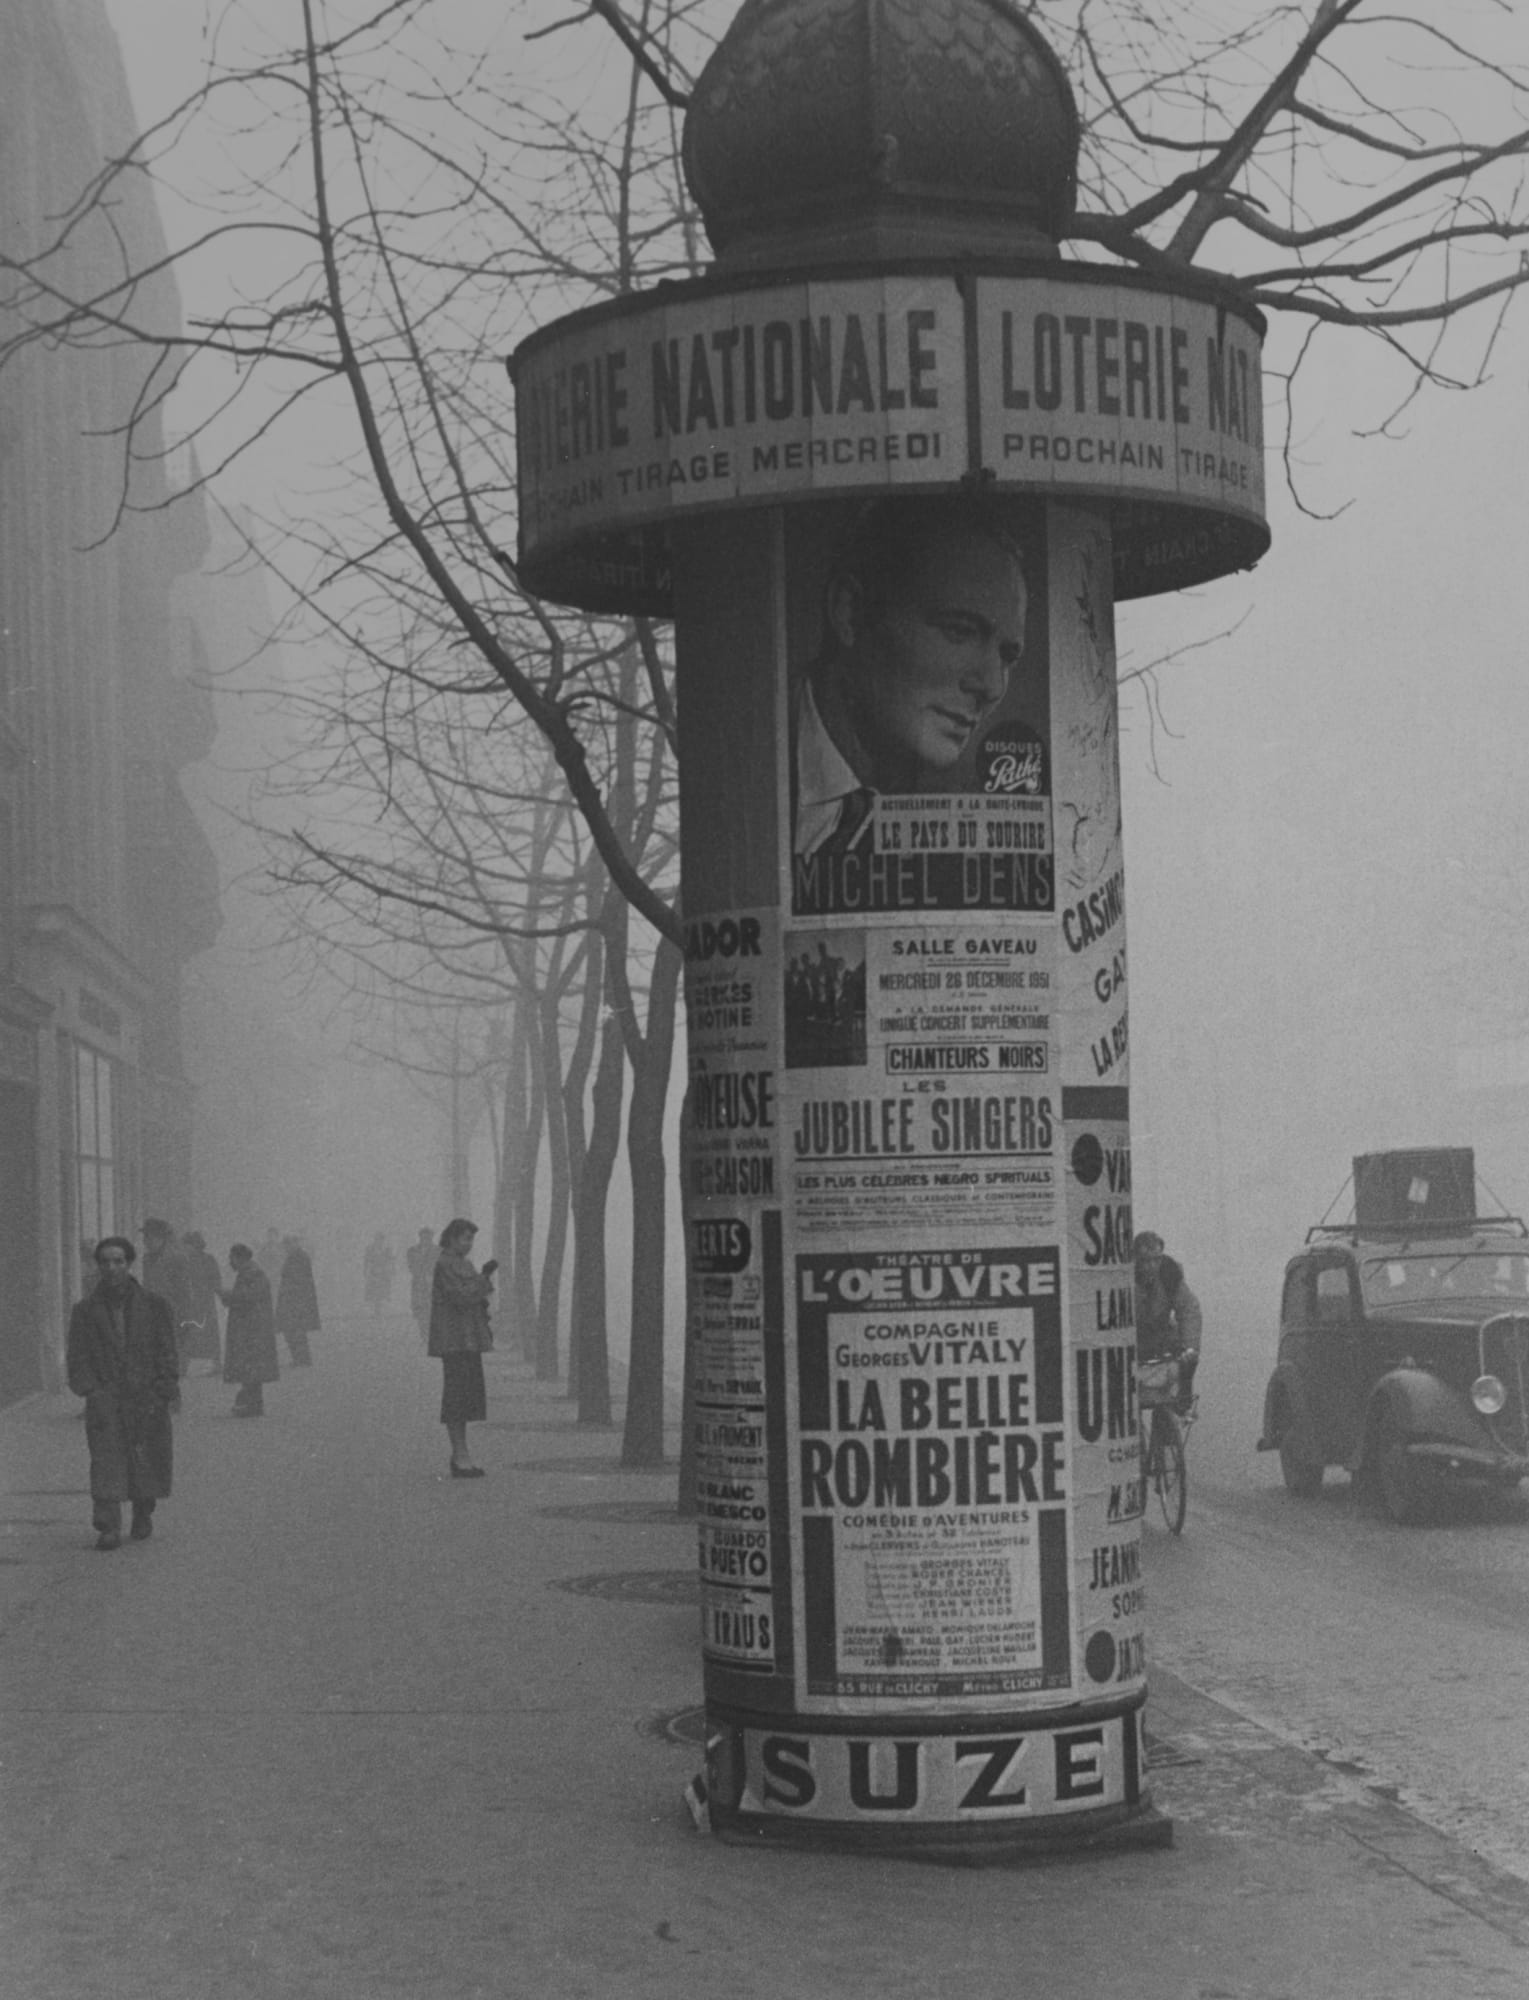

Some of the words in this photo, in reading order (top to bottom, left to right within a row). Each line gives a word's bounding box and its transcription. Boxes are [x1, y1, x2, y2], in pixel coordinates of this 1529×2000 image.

[652, 309, 938, 441] NATIONALE
[1002, 310, 1189, 424] LOTERIE
[616, 452, 729, 494] TIRAGE
[753, 432, 940, 471] MERCREDI
[1003, 433, 1163, 470] PROCHAIN
[1180, 448, 1248, 488] TIRAGE
[985, 741, 1042, 754] DISQUES
[881, 821, 901, 850] LE
[910, 820, 949, 849] PAYS
[958, 820, 977, 849] DU
[987, 821, 1046, 850] SOURIRE
[797, 852, 939, 909] MICHEL
[963, 852, 1051, 907] DENS
[892, 939, 955, 956] SALLE
[965, 938, 1038, 955] GAVEAU
[879, 972, 942, 990] MERCREDI
[1029, 971, 1050, 989] 1951
[920, 1014, 967, 1031] CONCERT
[889, 1046, 990, 1070] CHANTEURS
[998, 1045, 1045, 1069] NOIRS
[902, 1079, 948, 1093] LES
[794, 1098, 915, 1155] JUBILEE
[931, 1096, 1052, 1152] SINGERS
[714, 1156, 774, 1196] SAISON
[797, 1176, 820, 1189] LES
[824, 1174, 857, 1189] PLUS
[984, 1170, 1052, 1185] SPIRITUALS
[960, 1252, 983, 1265] DE
[864, 1320, 1000, 1341] COMPAGNIE
[908, 1337, 1027, 1368] VITALY
[837, 1378, 888, 1432] LA
[900, 1373, 1030, 1431] BELLE
[801, 1430, 1067, 1508] ROMBIÈRE
[710, 1546, 768, 1578] PUEYO
[975, 1557, 1011, 1569] VITALY
[918, 1598, 958, 1609] JEAN
[922, 1608, 964, 1619] HENRI
[951, 1655, 989, 1667] MICHEL
[895, 1681, 939, 1694] CLICHY
[1002, 1677, 1043, 1691] CLICHY
[762, 1727, 1104, 1810] SUZE
